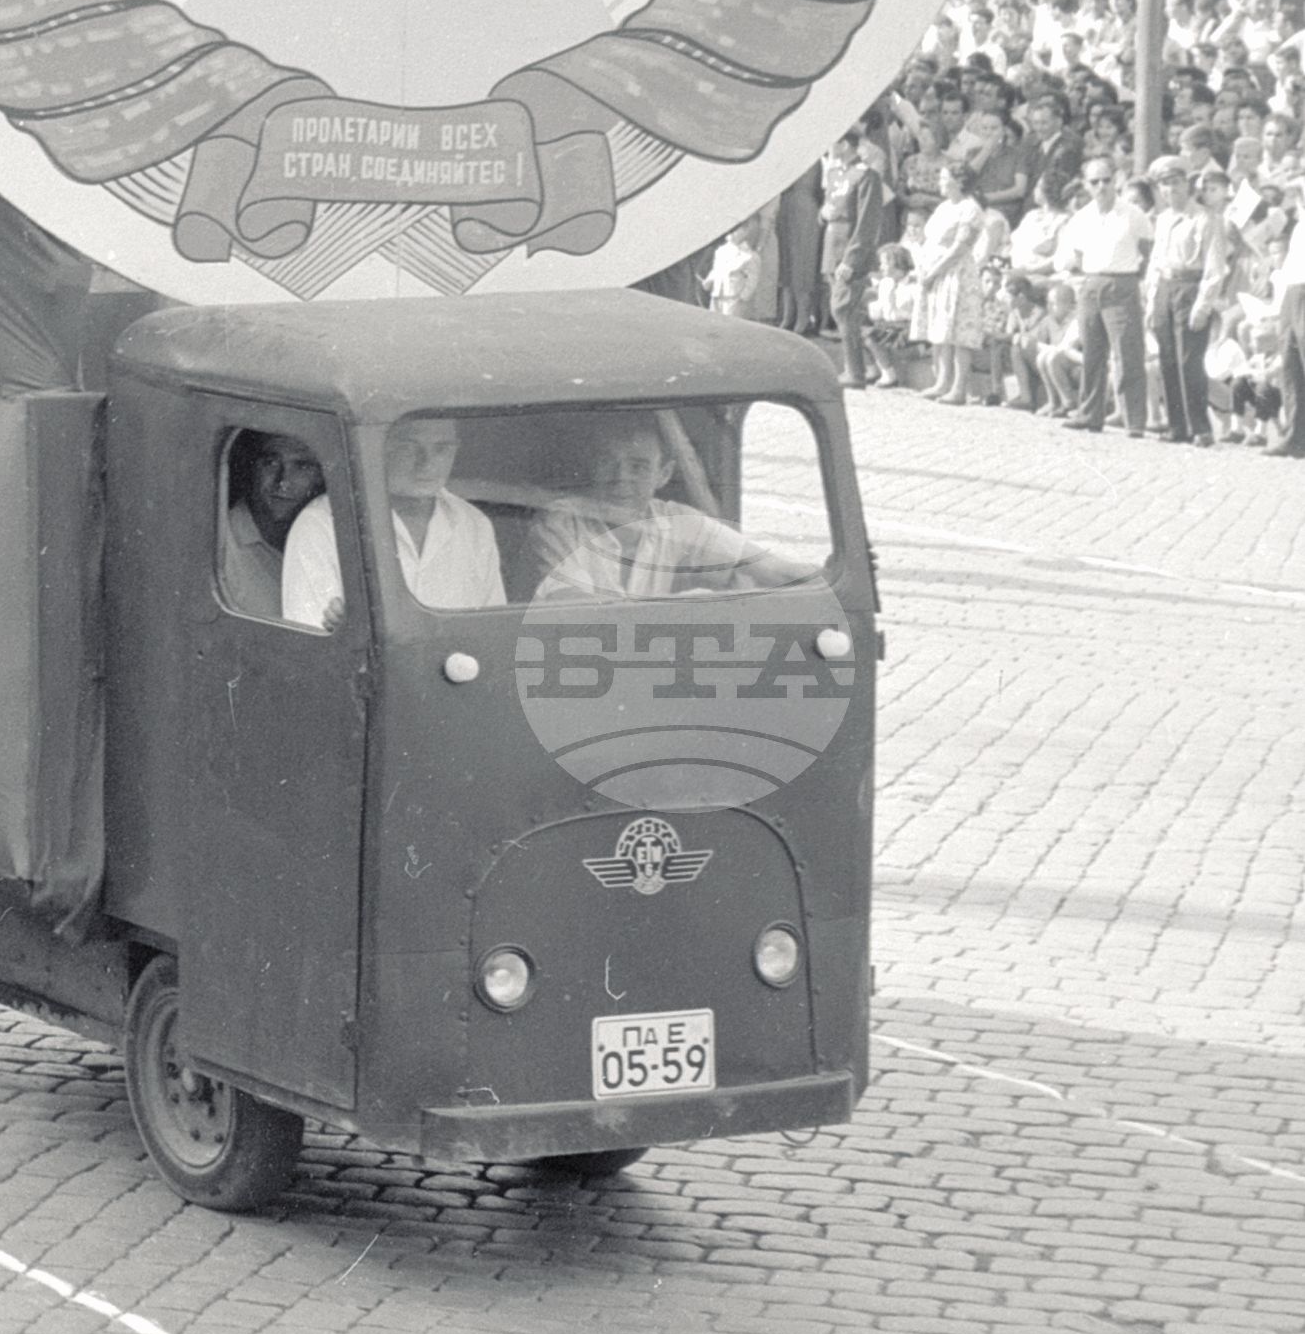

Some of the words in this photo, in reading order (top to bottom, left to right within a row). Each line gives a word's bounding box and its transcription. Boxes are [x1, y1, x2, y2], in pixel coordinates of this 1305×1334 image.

[292, 116, 419, 149] ПРОЛЕТАРИИ
[441, 123, 498, 150] ВСЕХ
[284, 152, 356, 182] СТРАН,
[601, 1045, 707, 1090] 05-59
